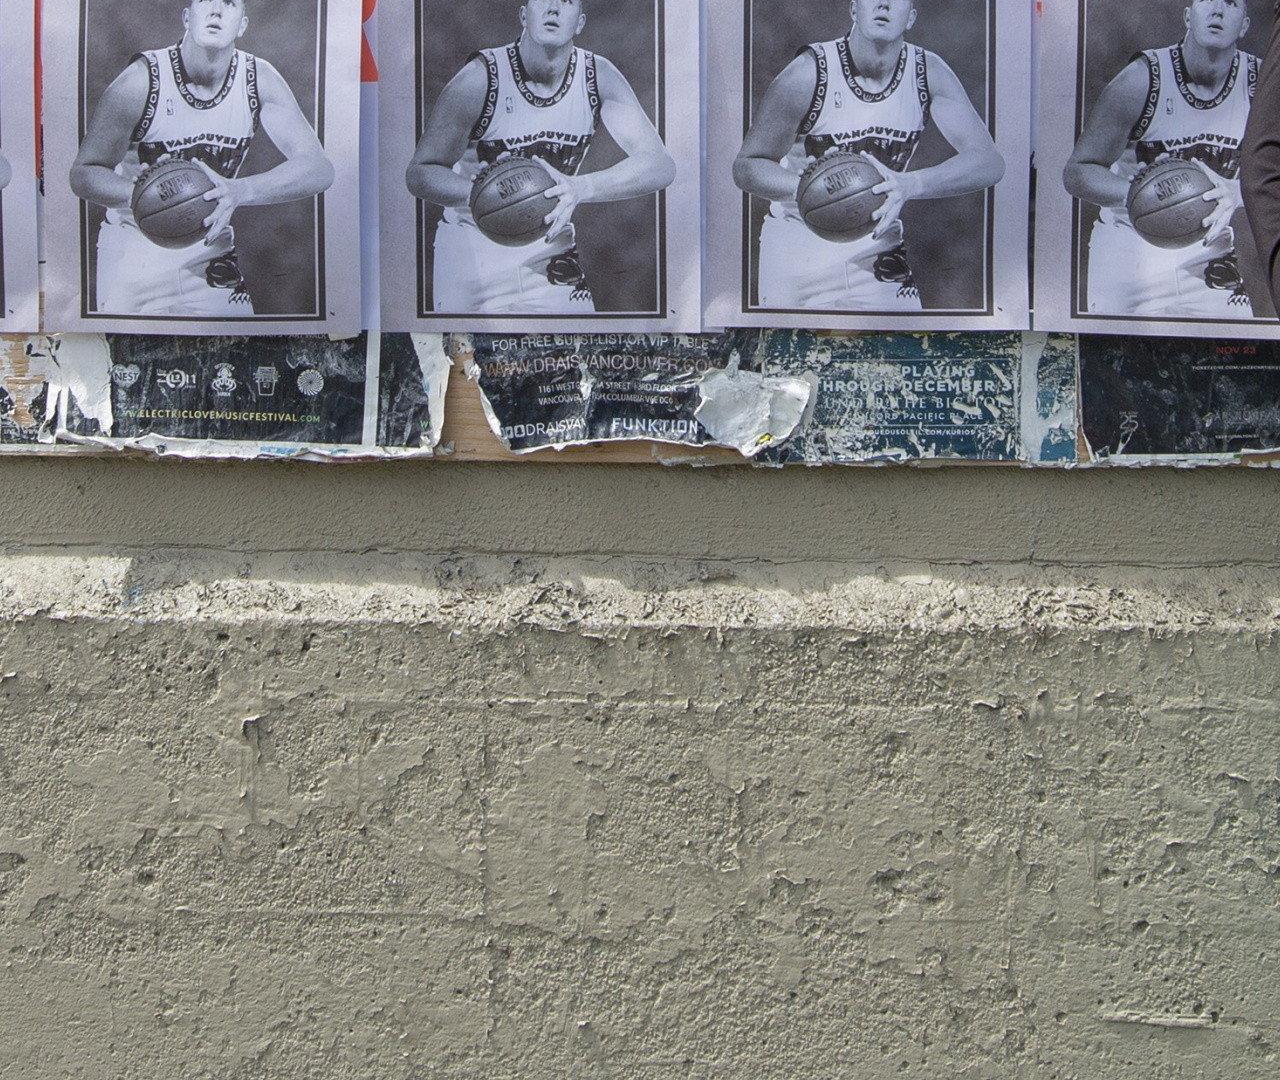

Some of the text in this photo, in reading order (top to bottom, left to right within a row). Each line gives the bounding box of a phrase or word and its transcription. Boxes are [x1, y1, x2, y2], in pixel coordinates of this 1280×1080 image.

[165, 133, 238, 149] VANCOUVER
[506, 130, 579, 146] VANCOUVER
[834, 126, 908, 141] VANCOUVER
[1164, 133, 1239, 148] VANCOUVER
[492, 338, 518, 352] FOR
[521, 335, 552, 349] FREE
[649, 334, 669, 348] VIP
[901, 365, 976, 378] PLAYING
[903, 379, 995, 392] DECEMBER
[825, 397, 884, 409] UNDR
[903, 412, 946, 421] PACIFIC
